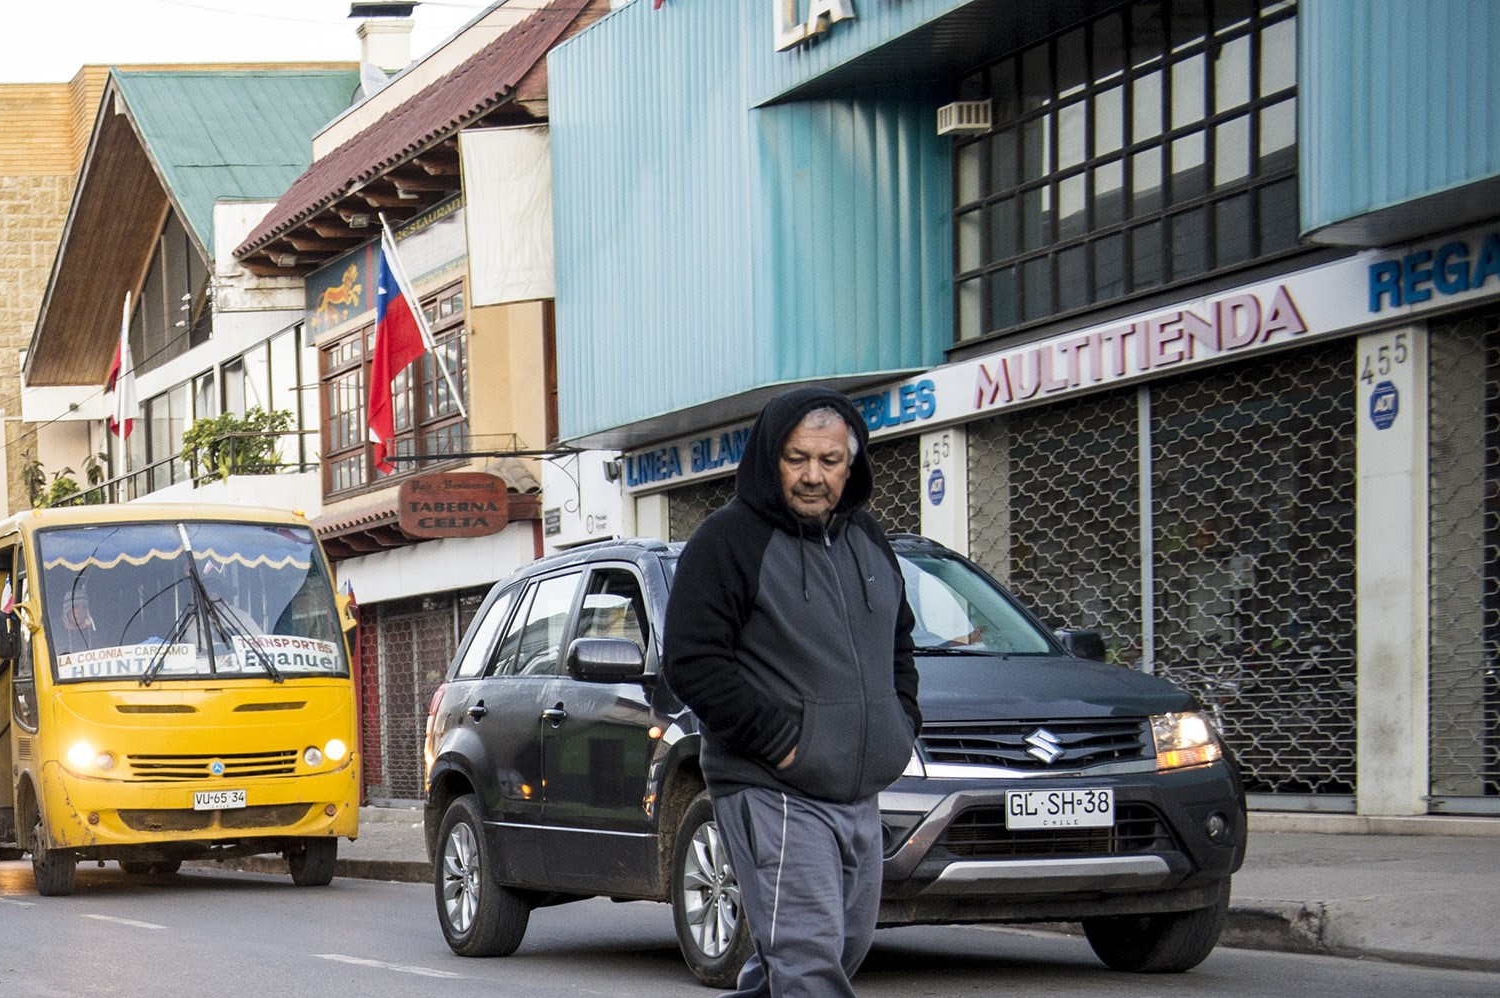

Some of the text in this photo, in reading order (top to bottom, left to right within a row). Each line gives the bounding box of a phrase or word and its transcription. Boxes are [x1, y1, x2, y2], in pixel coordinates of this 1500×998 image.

[974, 284, 1309, 410] MULTITIENDA
[1360, 333, 1408, 385] 455
[1373, 393, 1397, 413] ADT
[922, 434, 950, 472] 455
[626, 446, 683, 488] LINEA
[408, 501, 499, 512] TABERNA
[417, 517, 489, 529] CELTA
[58, 656, 72, 667] LA
[1042, 818, 1080, 826] CHILE
